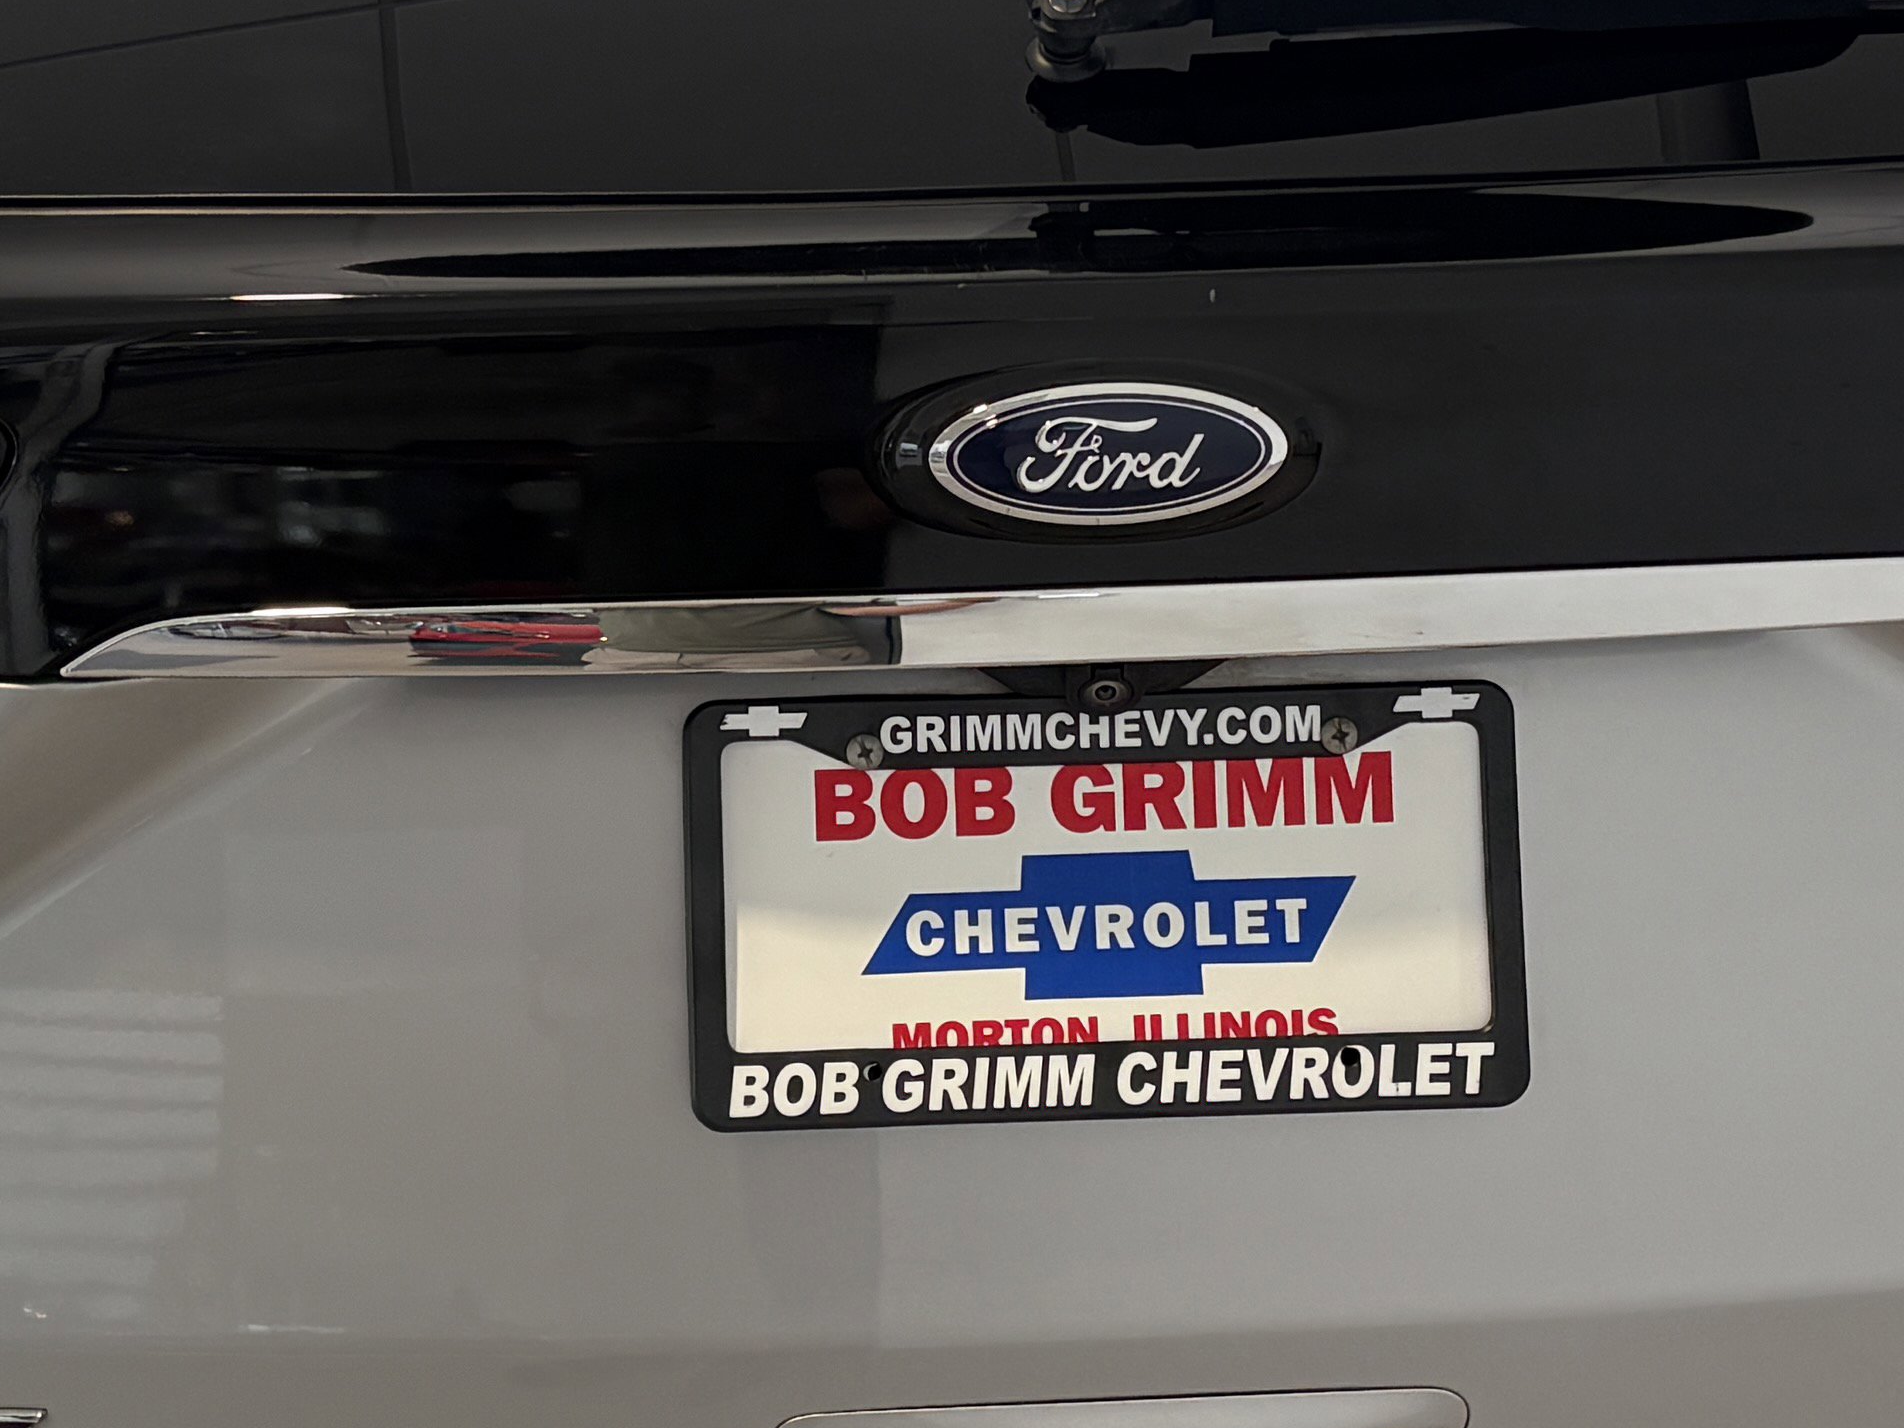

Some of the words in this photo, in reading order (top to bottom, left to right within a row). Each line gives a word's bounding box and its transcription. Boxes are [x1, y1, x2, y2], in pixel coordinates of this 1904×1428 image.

[1016, 416, 1205, 494] Ford
[879, 703, 1322, 755] GRIMMCHEVY.COM
[813, 765, 1017, 843] BOB
[1050, 751, 1395, 834] GRIMM
[905, 897, 1309, 959] CHEVROLET
[728, 1060, 862, 1119] BOB
[881, 1054, 1098, 1112] GRIMM
[1116, 1042, 1496, 1107] CHEVROLET
